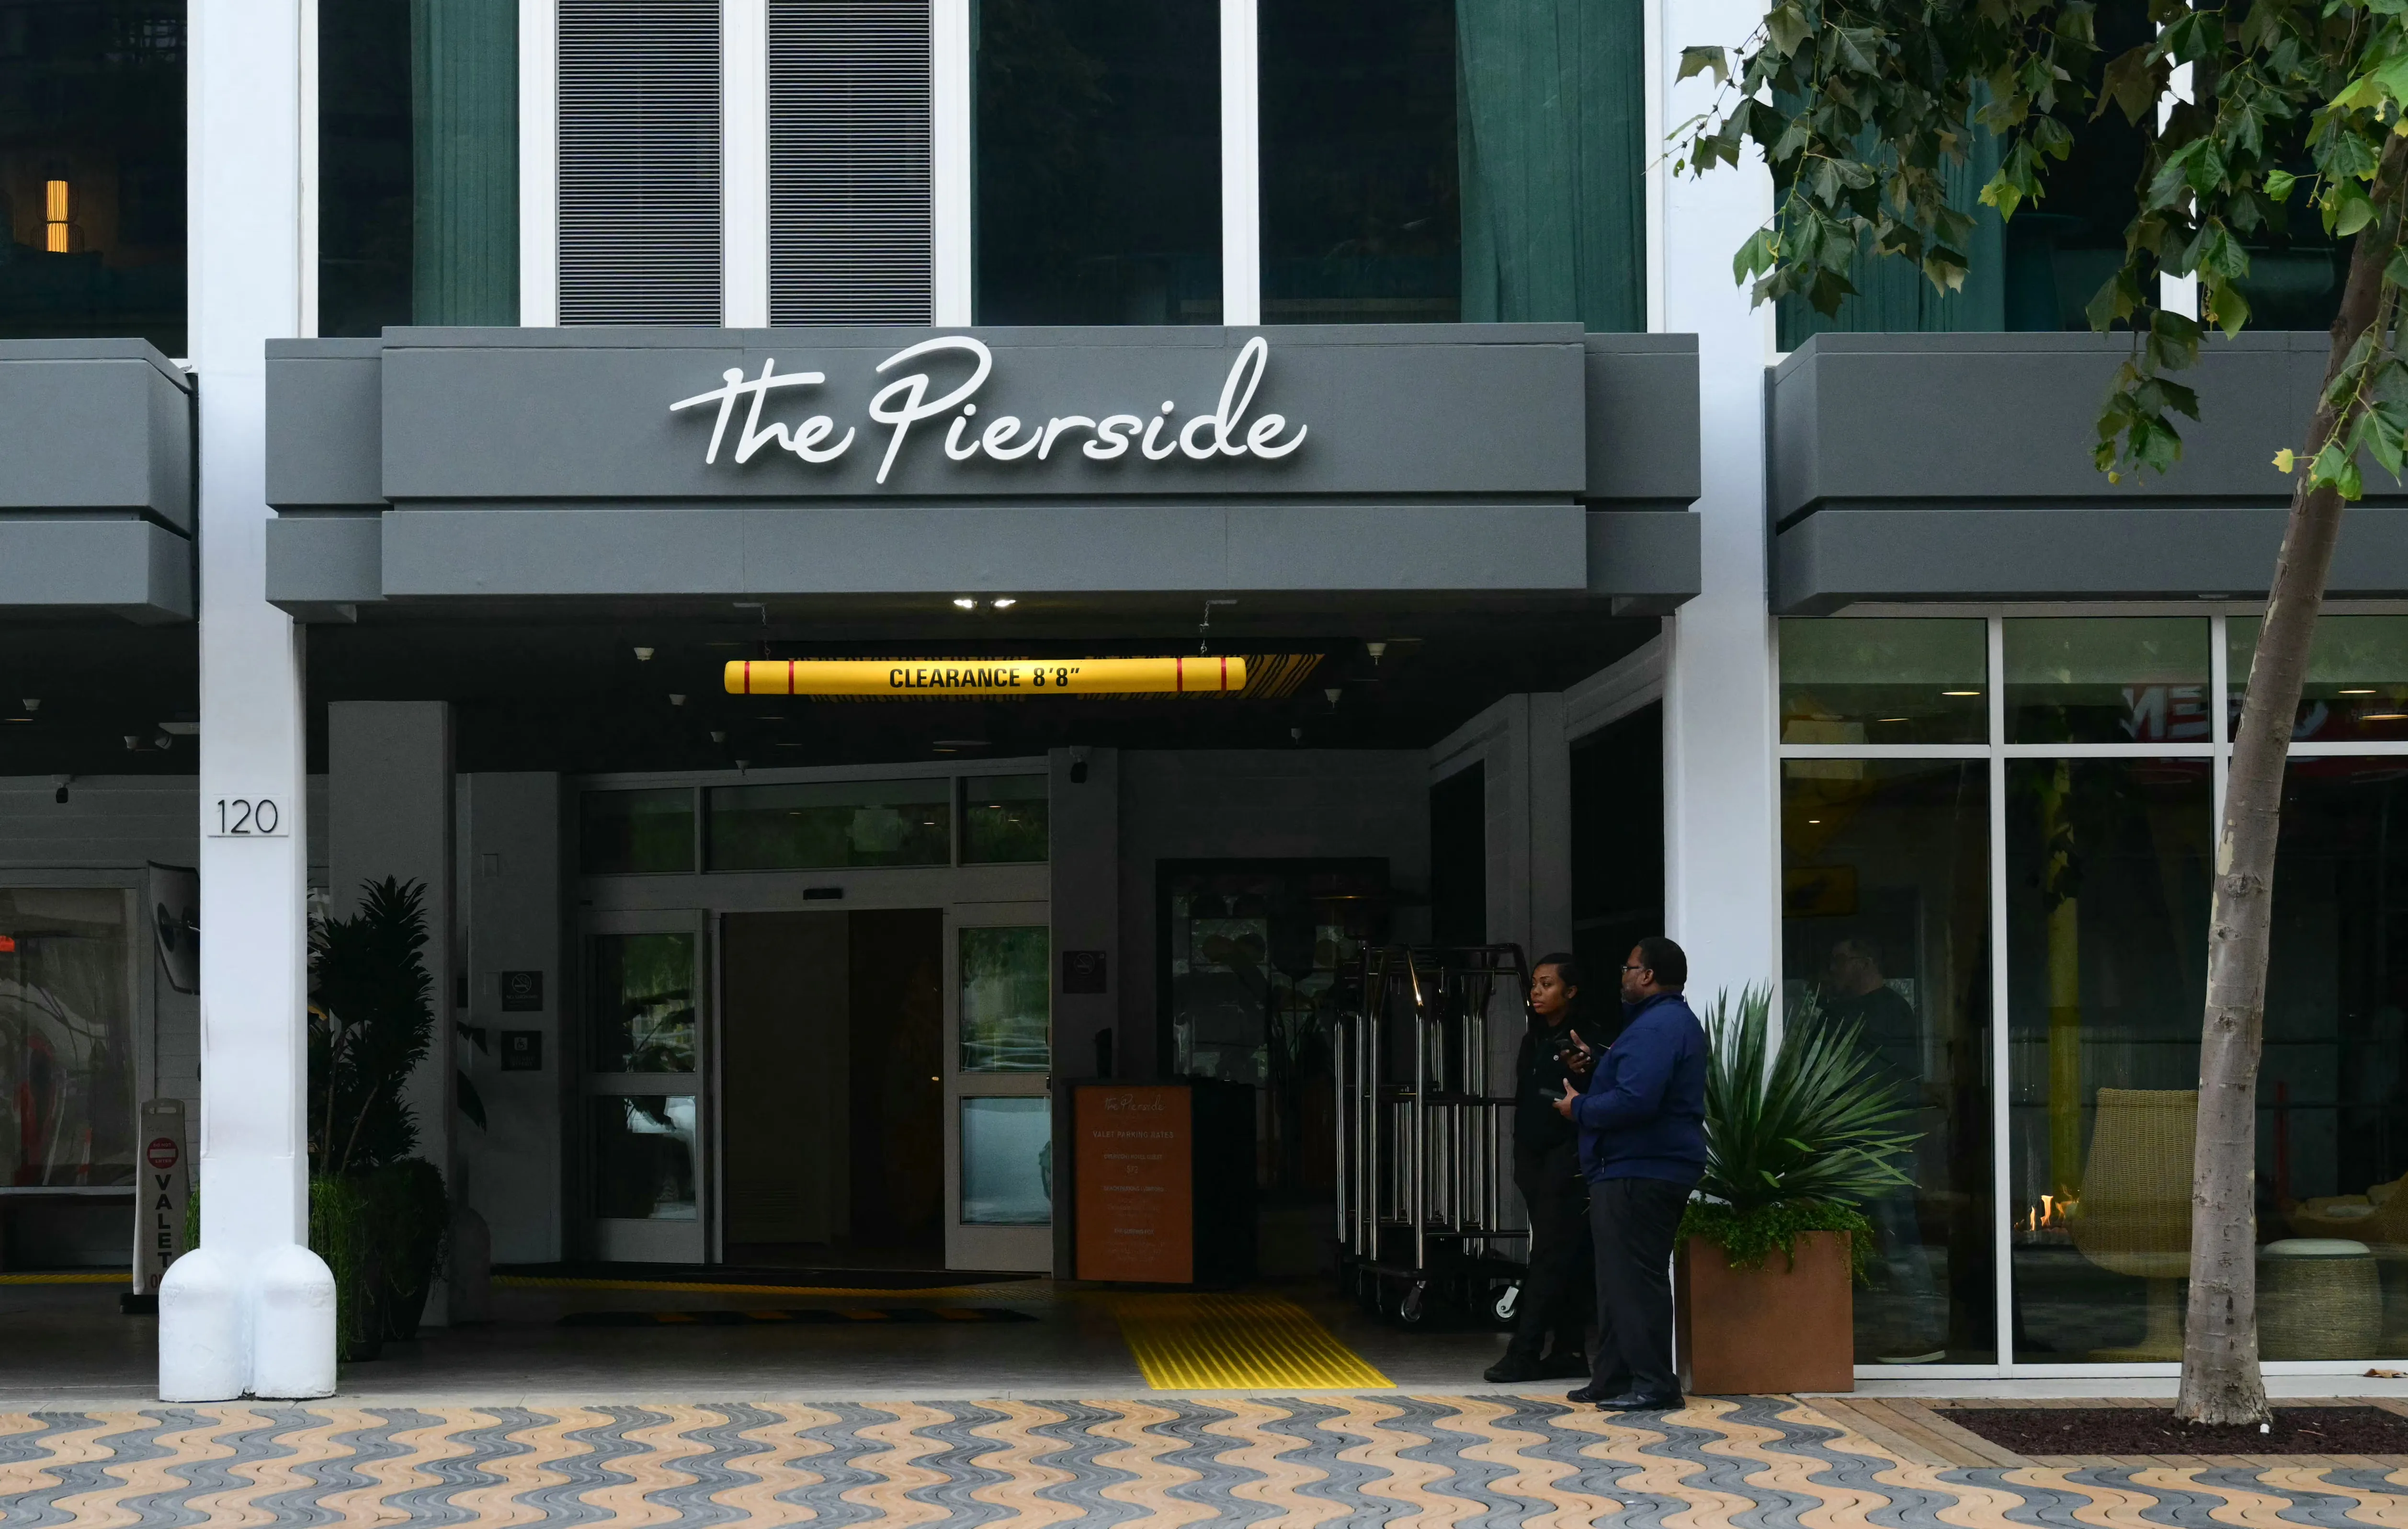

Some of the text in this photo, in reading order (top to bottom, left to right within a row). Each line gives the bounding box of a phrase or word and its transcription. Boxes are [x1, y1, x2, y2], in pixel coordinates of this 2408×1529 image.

[868, 336, 1307, 484] Pierside
[889, 668, 1021, 688] CLEARANCE
[217, 799, 278, 833] 120
[155, 1174, 173, 1268] VALET
